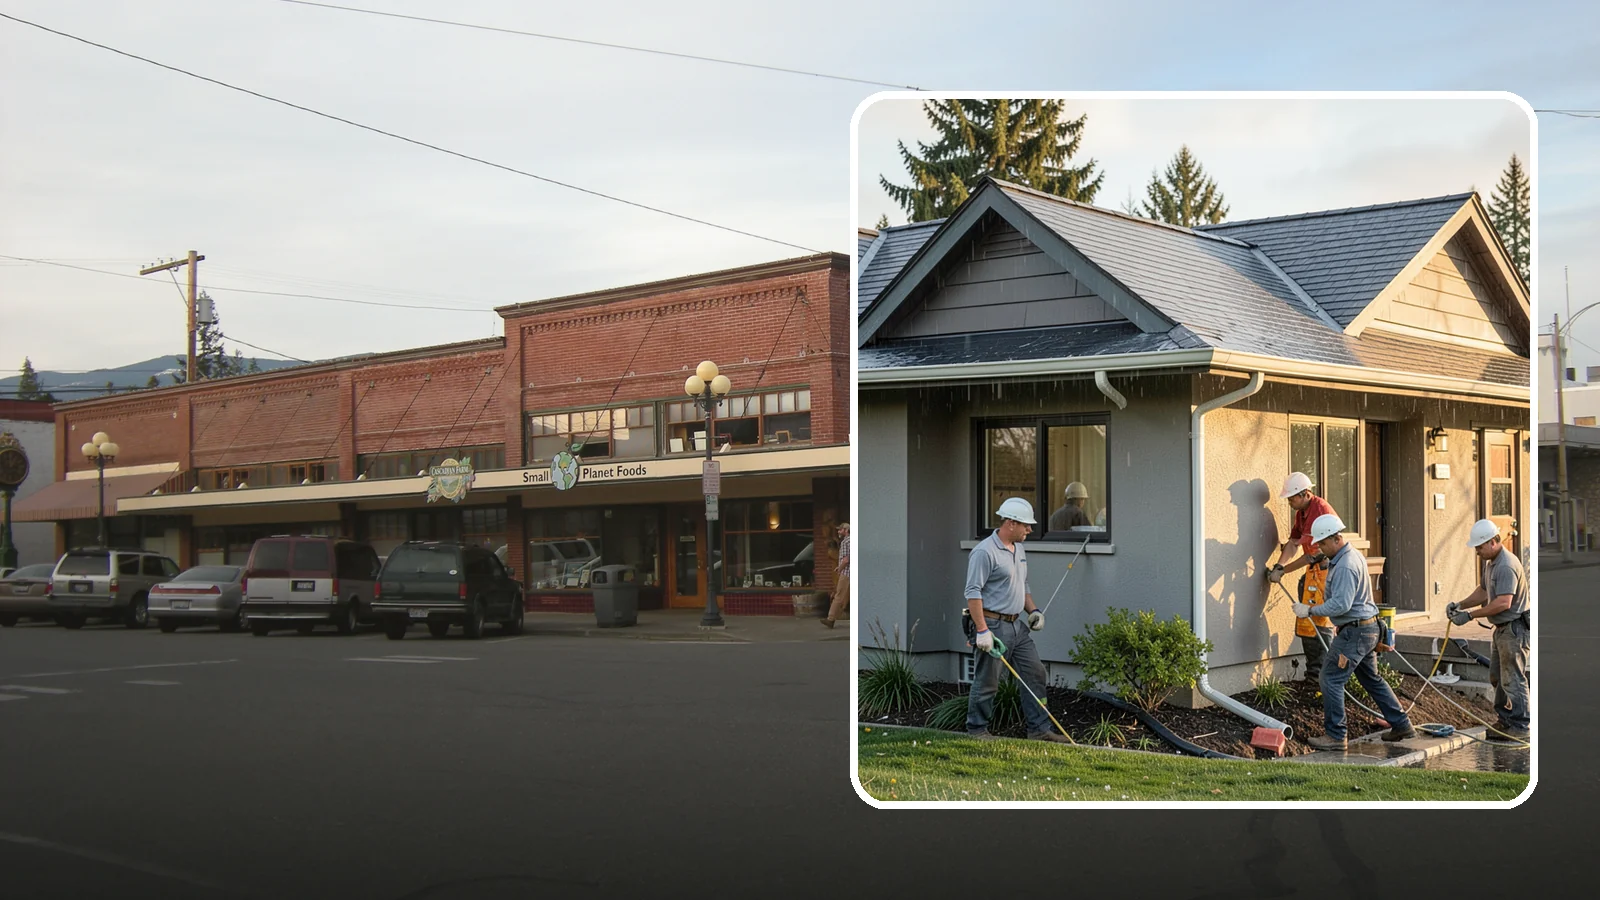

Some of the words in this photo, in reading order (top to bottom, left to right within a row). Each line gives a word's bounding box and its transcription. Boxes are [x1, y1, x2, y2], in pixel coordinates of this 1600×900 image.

[523, 471, 549, 482] Small
[583, 468, 614, 479] Planet
[617, 464, 647, 477] Foods
